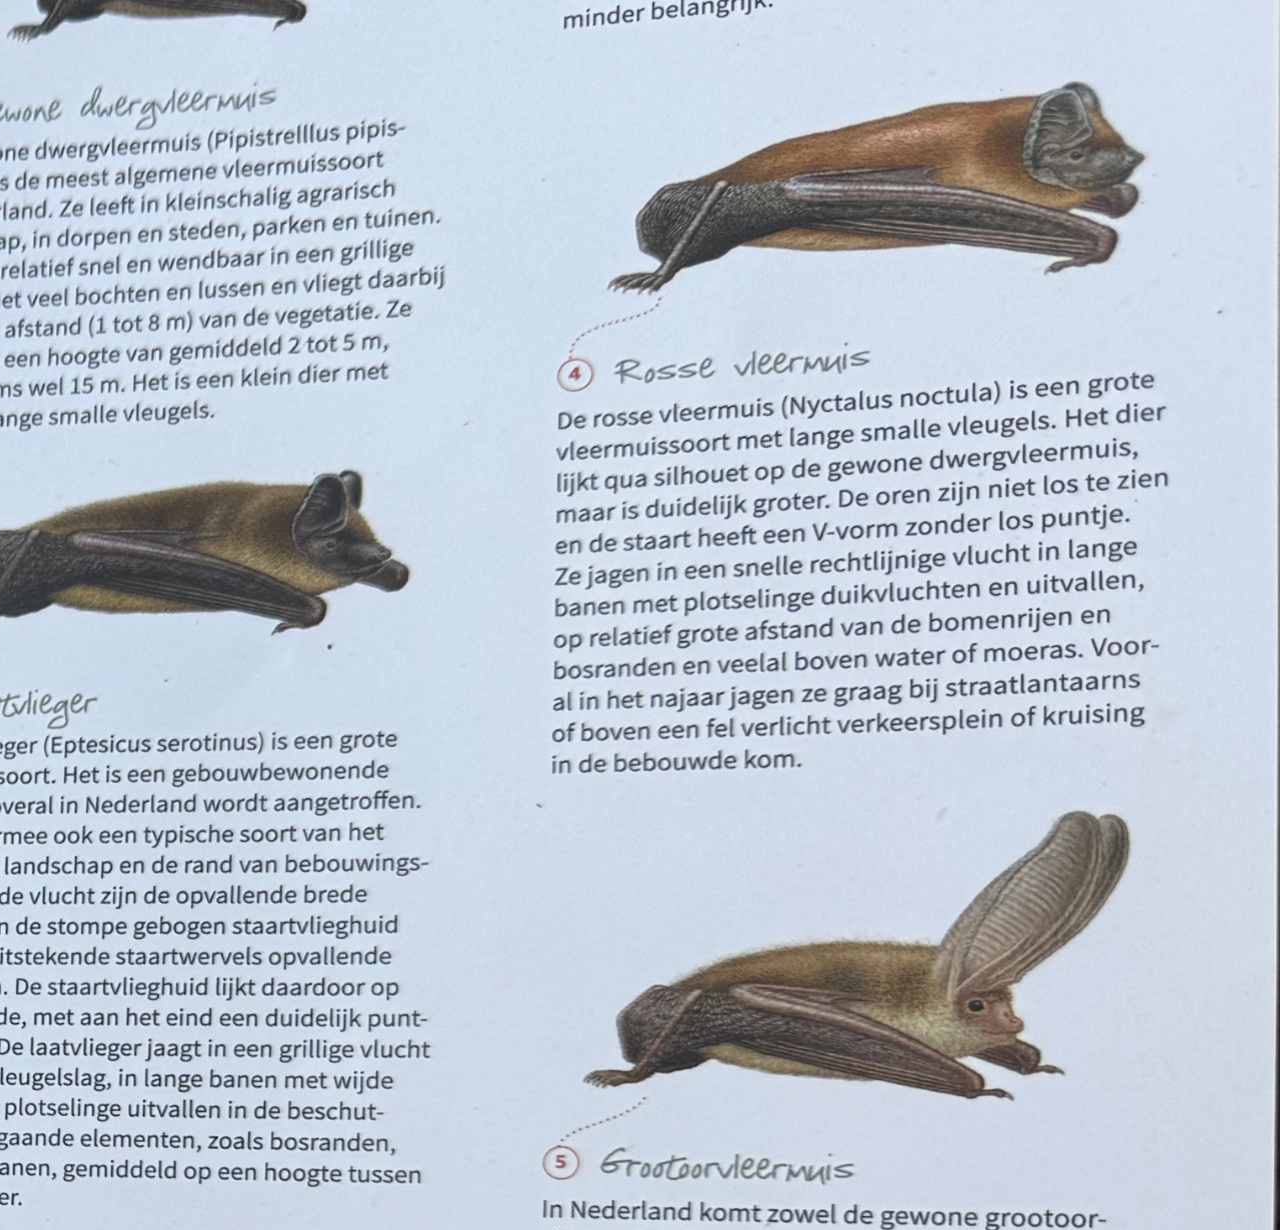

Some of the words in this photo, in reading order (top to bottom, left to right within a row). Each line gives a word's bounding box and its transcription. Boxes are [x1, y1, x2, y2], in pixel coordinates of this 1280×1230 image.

[563, 5, 644, 29] minder
[80, 81, 277, 130] dwergvleermuis
[35, 133, 201, 162] dwergvleermuis
[208, 124, 340, 153] (Pipistrelllus
[347, 119, 405, 145] pipis-
[569, 367, 581, 380] 4
[614, 357, 715, 384] Rosse
[734, 343, 870, 376] vleermuis
[49, 404, 117, 425] smalle
[123, 400, 214, 425] vleugels.
[555, 598, 625, 617] banen
[633, 595, 678, 613] met
[685, 589, 814, 616] plotselinge
[822, 580, 980, 605] duikvluchten
[989, 581, 1018, 596] en
[1027, 570, 1144, 594] uitvallen,
[16, 978, 41, 995] De
[48, 977, 208, 1001] staartvlieghuid
[216, 977, 256, 1001] lijkt
[262, 977, 366, 996] daardoor
[371, 982, 399, 1000] op
[555, 1155, 567, 1168] 5
[600, 1147, 854, 1185] Grootoorvleermuis
